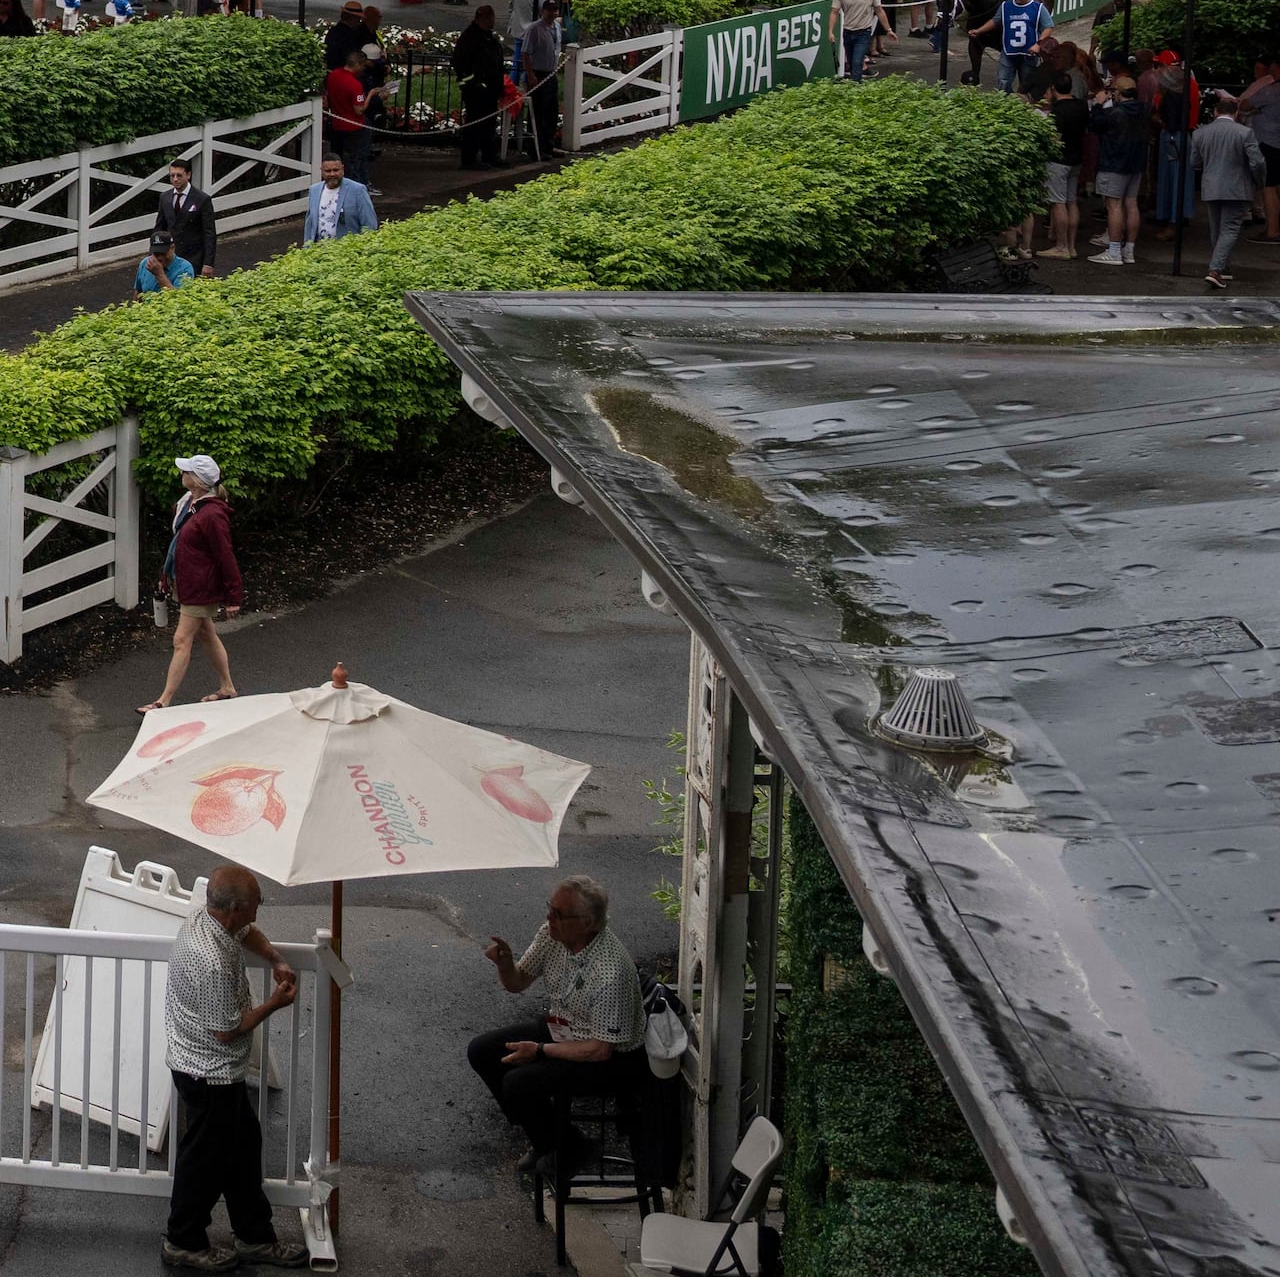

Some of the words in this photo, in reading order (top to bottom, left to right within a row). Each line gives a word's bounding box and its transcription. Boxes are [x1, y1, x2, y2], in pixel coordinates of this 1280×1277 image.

[705, 22, 772, 104] NYRA
[776, 11, 822, 51] BETS
[1009, 21, 1027, 47] 3
[347, 765, 406, 865] CHANDON
[407, 794, 429, 828] SPRITZ
